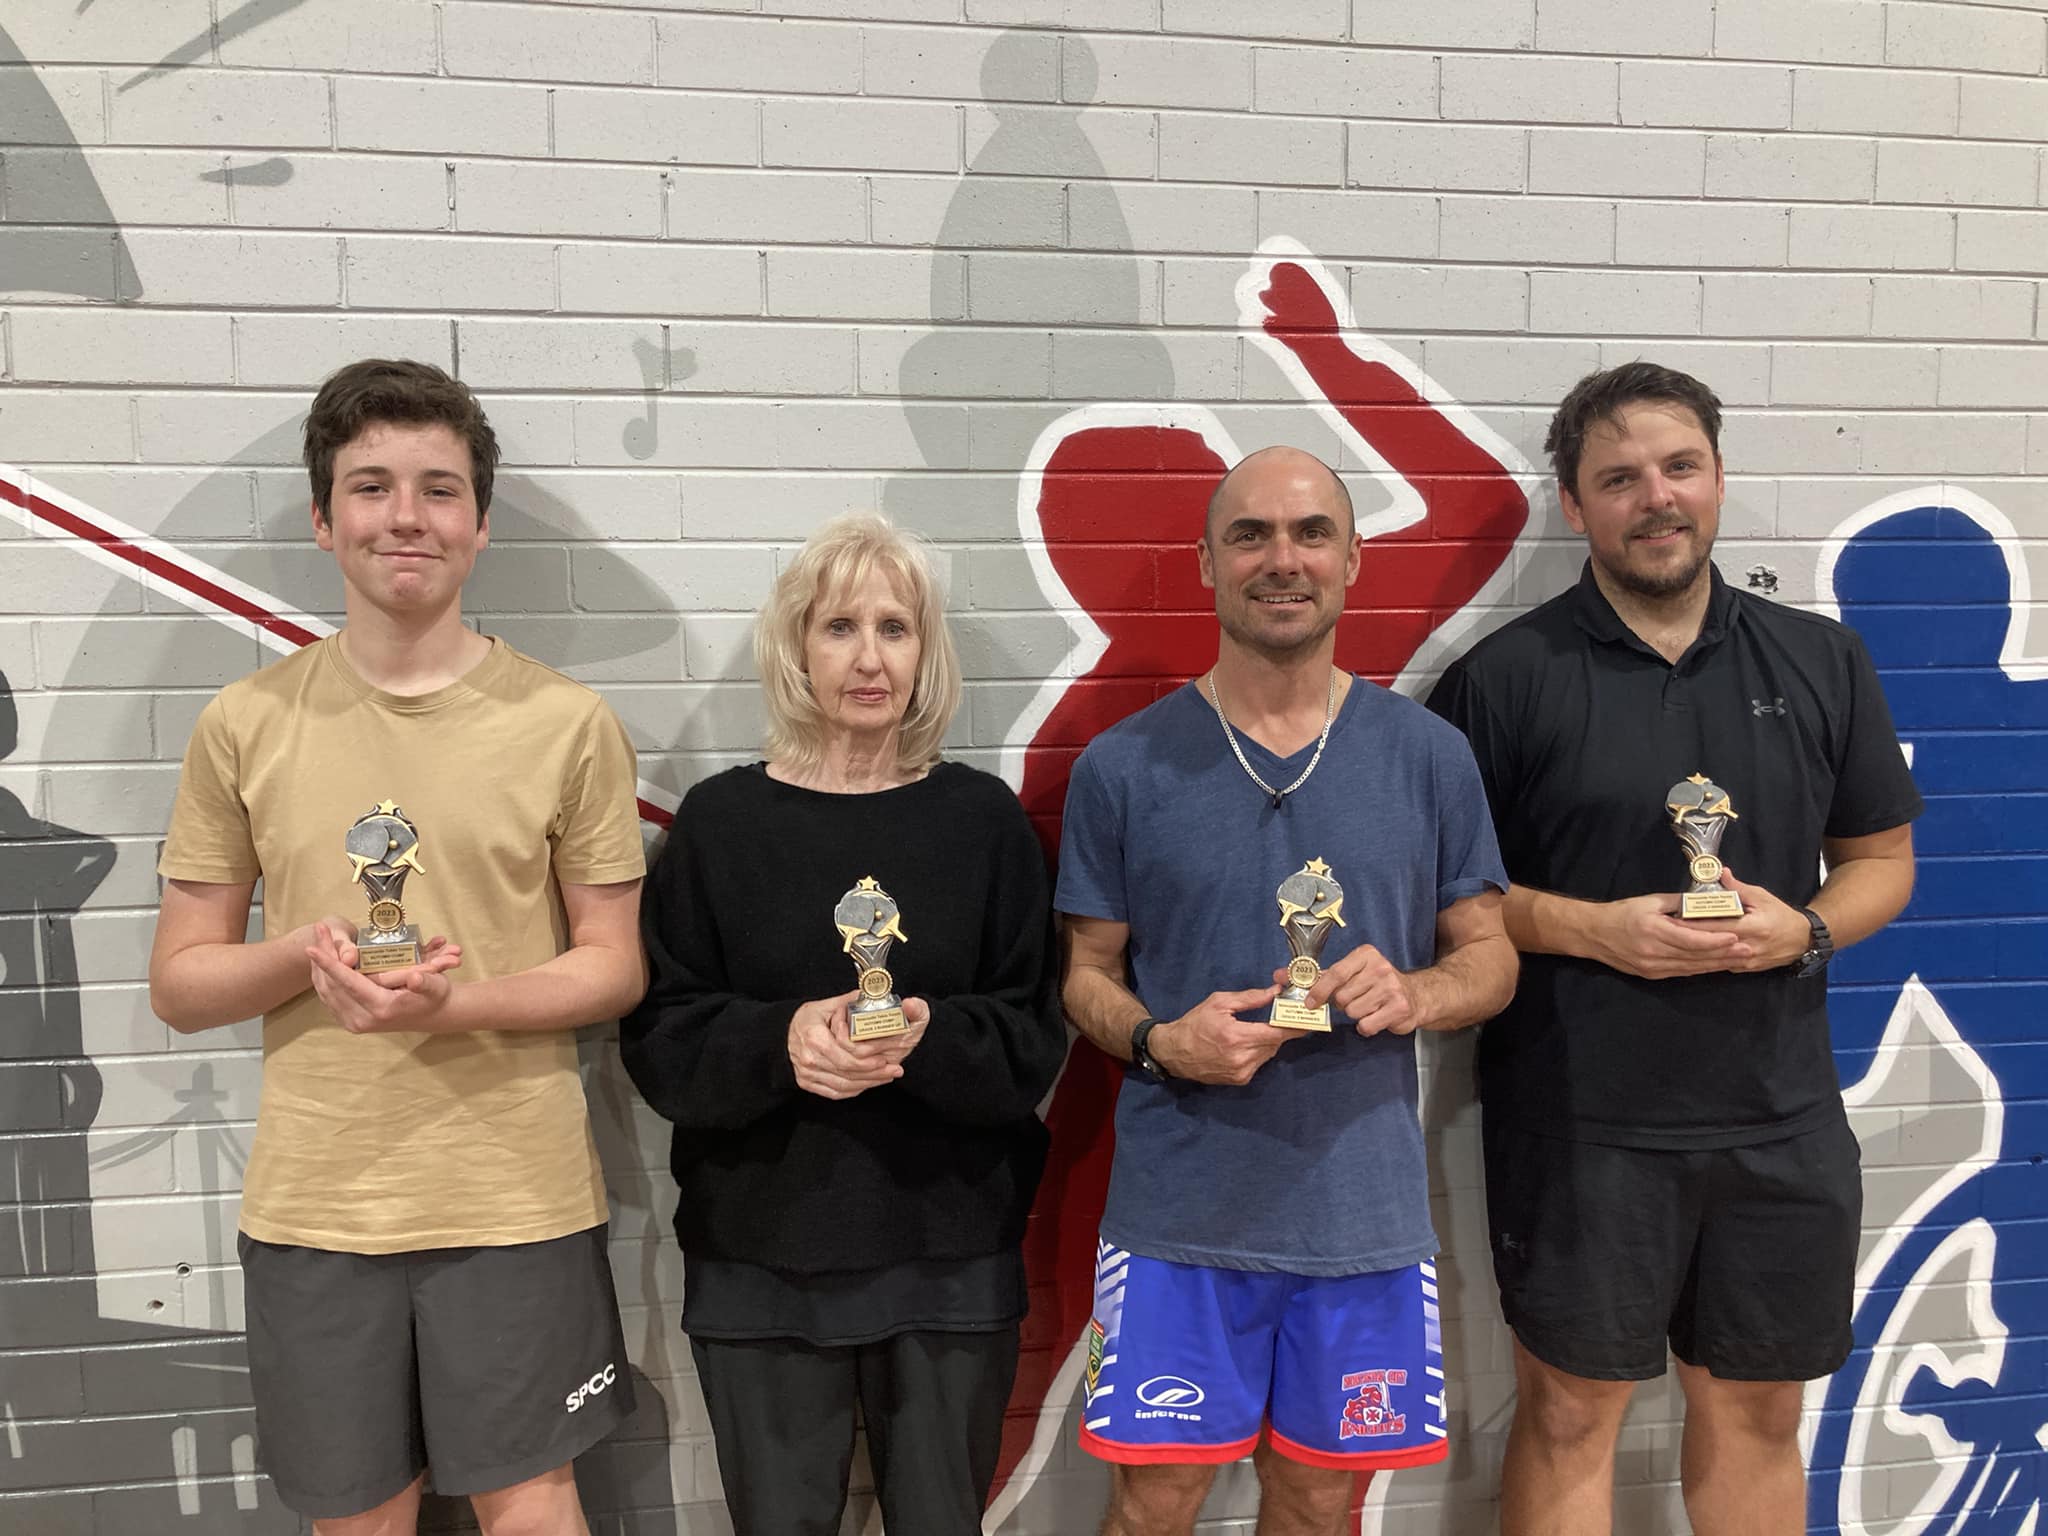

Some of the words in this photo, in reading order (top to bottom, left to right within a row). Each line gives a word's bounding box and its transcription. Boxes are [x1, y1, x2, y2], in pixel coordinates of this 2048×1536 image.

[376, 909, 396, 917] 2023
[867, 976, 885, 985] 2023
[565, 1363, 616, 1413] SPCC
